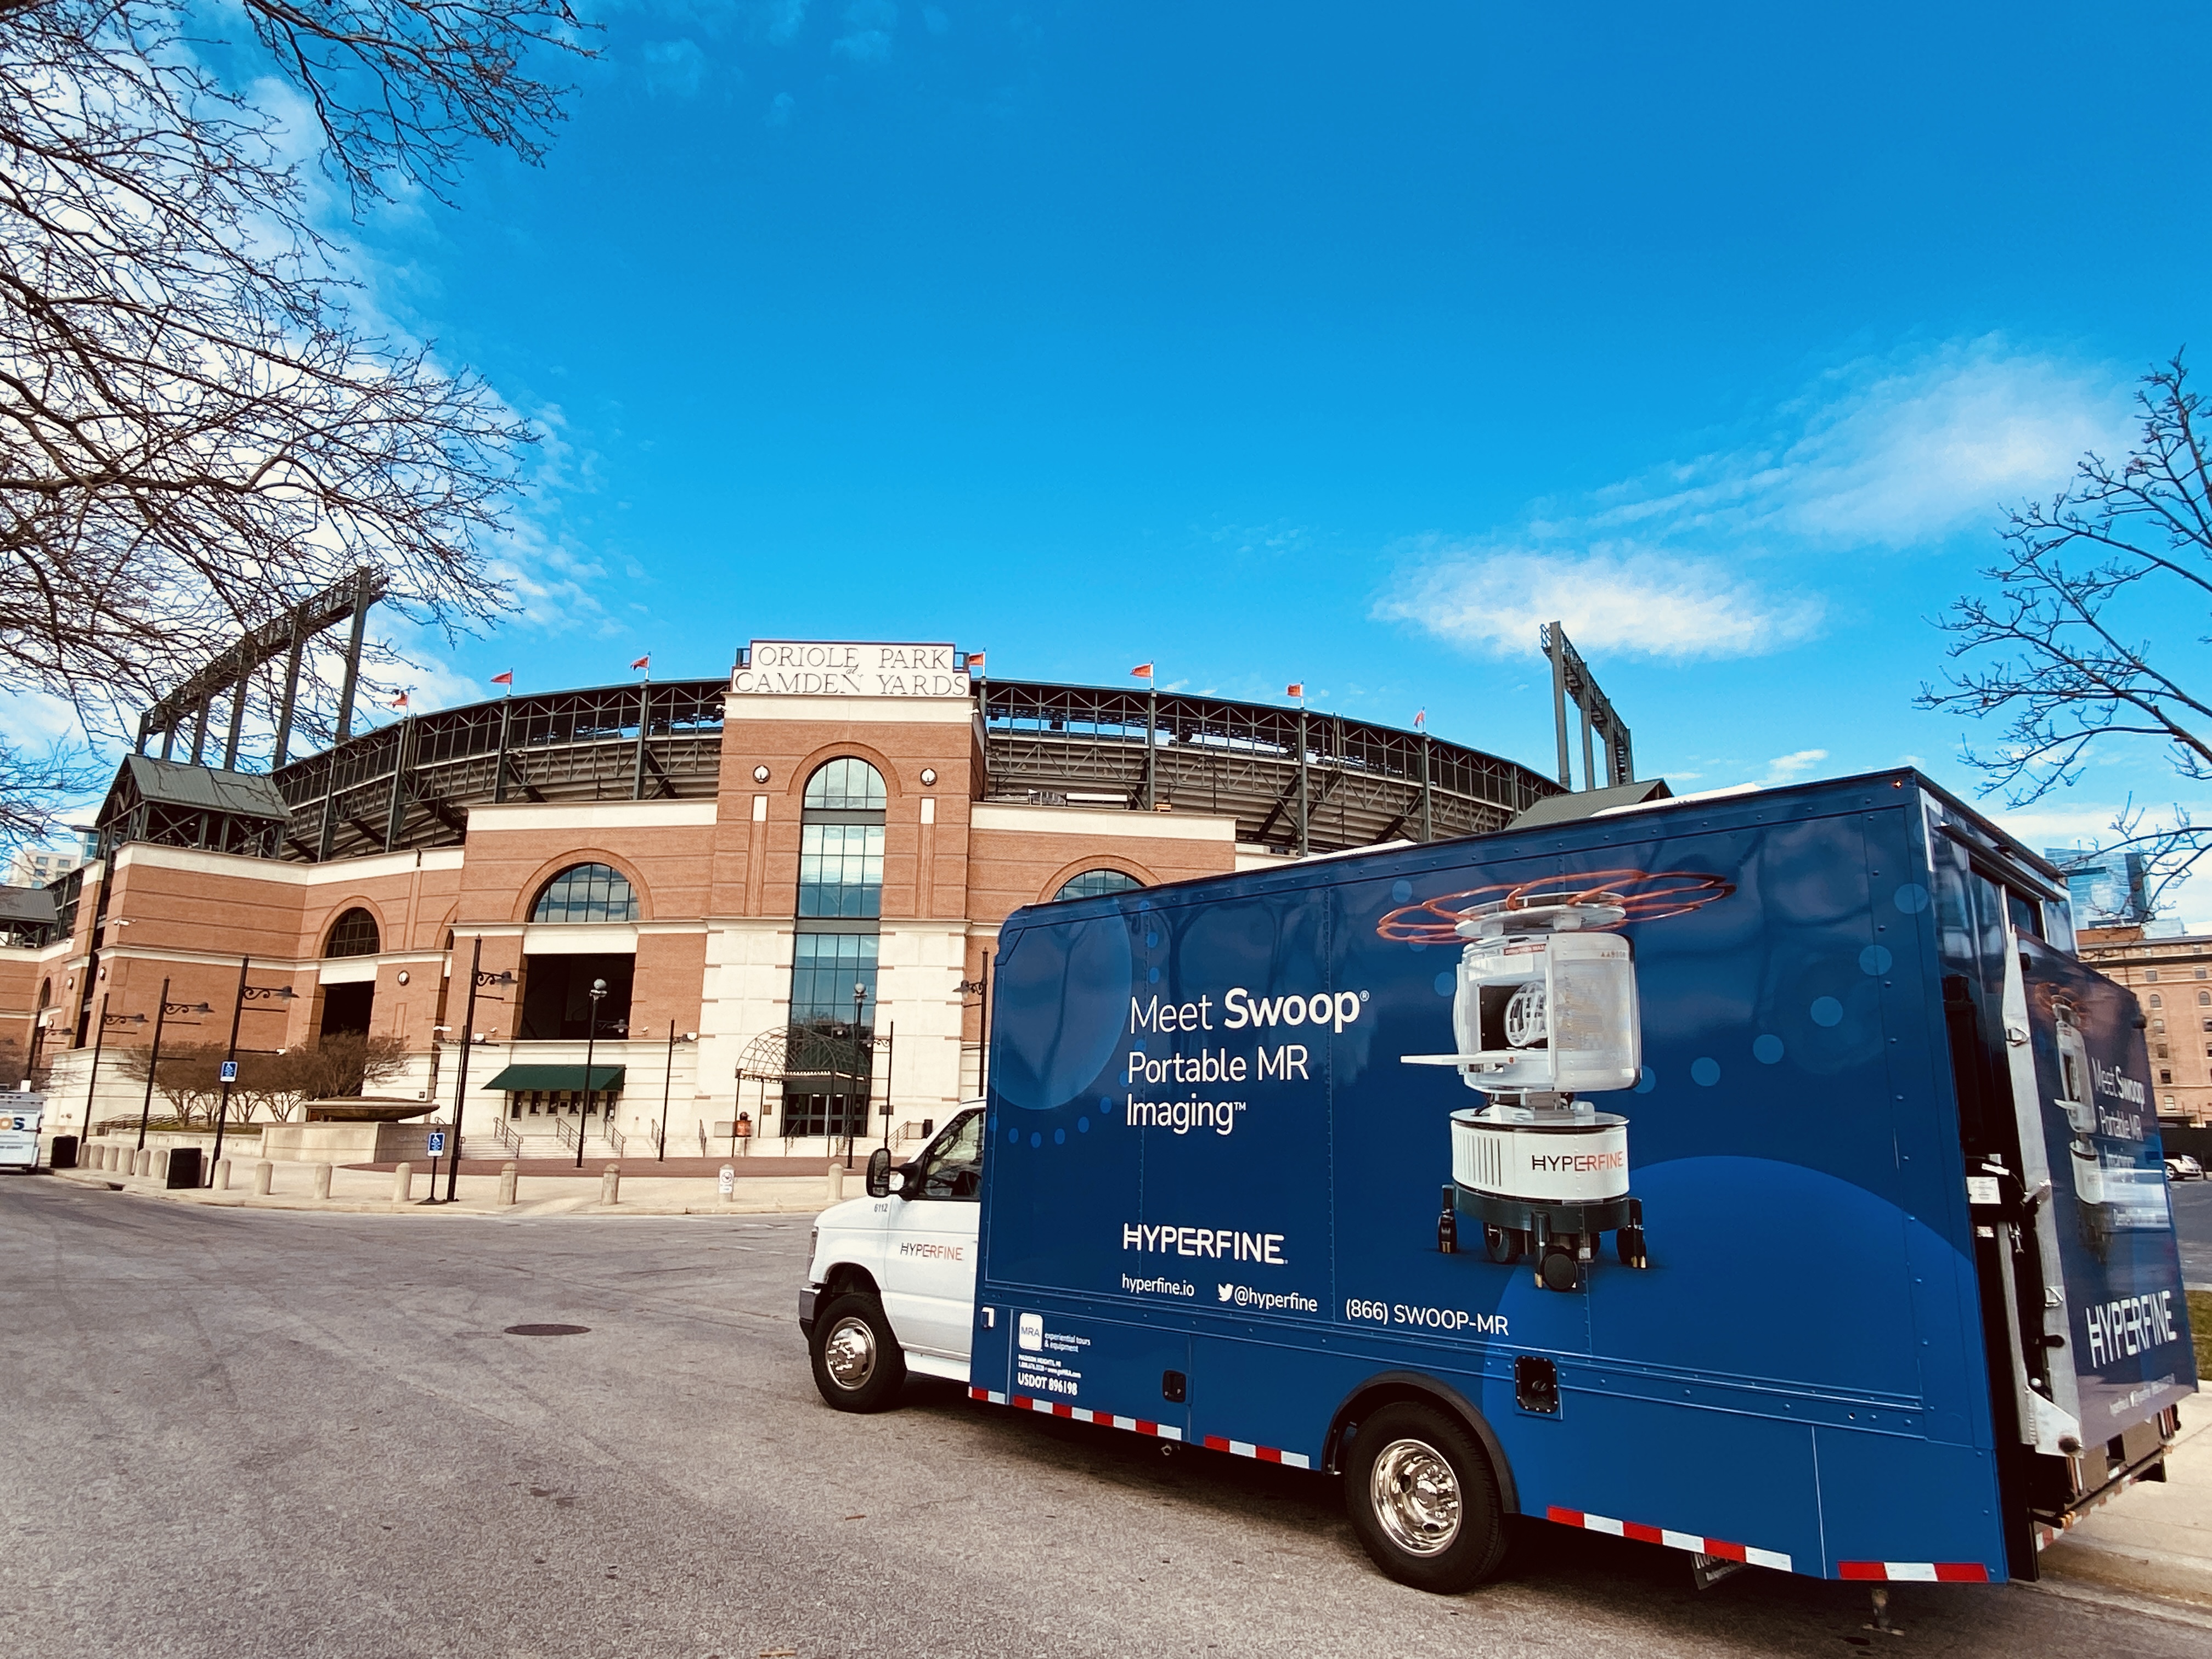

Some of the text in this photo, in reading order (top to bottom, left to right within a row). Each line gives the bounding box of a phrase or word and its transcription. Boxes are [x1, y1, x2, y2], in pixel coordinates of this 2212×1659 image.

[758, 646, 949, 669] ORIOLE PARK
[735, 672, 966, 695] CAMDEN YARDS
[1131, 995, 1213, 1034] Meet
[1128, 1045, 1309, 1084] Portable MR
[1532, 1151, 1623, 1172] HYPERFINE
[900, 1242, 964, 1261] HYPERFINE
[1123, 1223, 1286, 1265] HYPERFINE
[1122, 1273, 1195, 1297] hyperfine.io
[1234, 1286, 1317, 1312] @hyperfine
[1346, 1299, 1509, 1336] (866) SWOOP-MR
[2086, 1290, 2177, 1368] HYPERFINE
[1021, 1327, 1040, 1337] MRA
[1018, 1372, 1078, 1396] USDOT 896198
